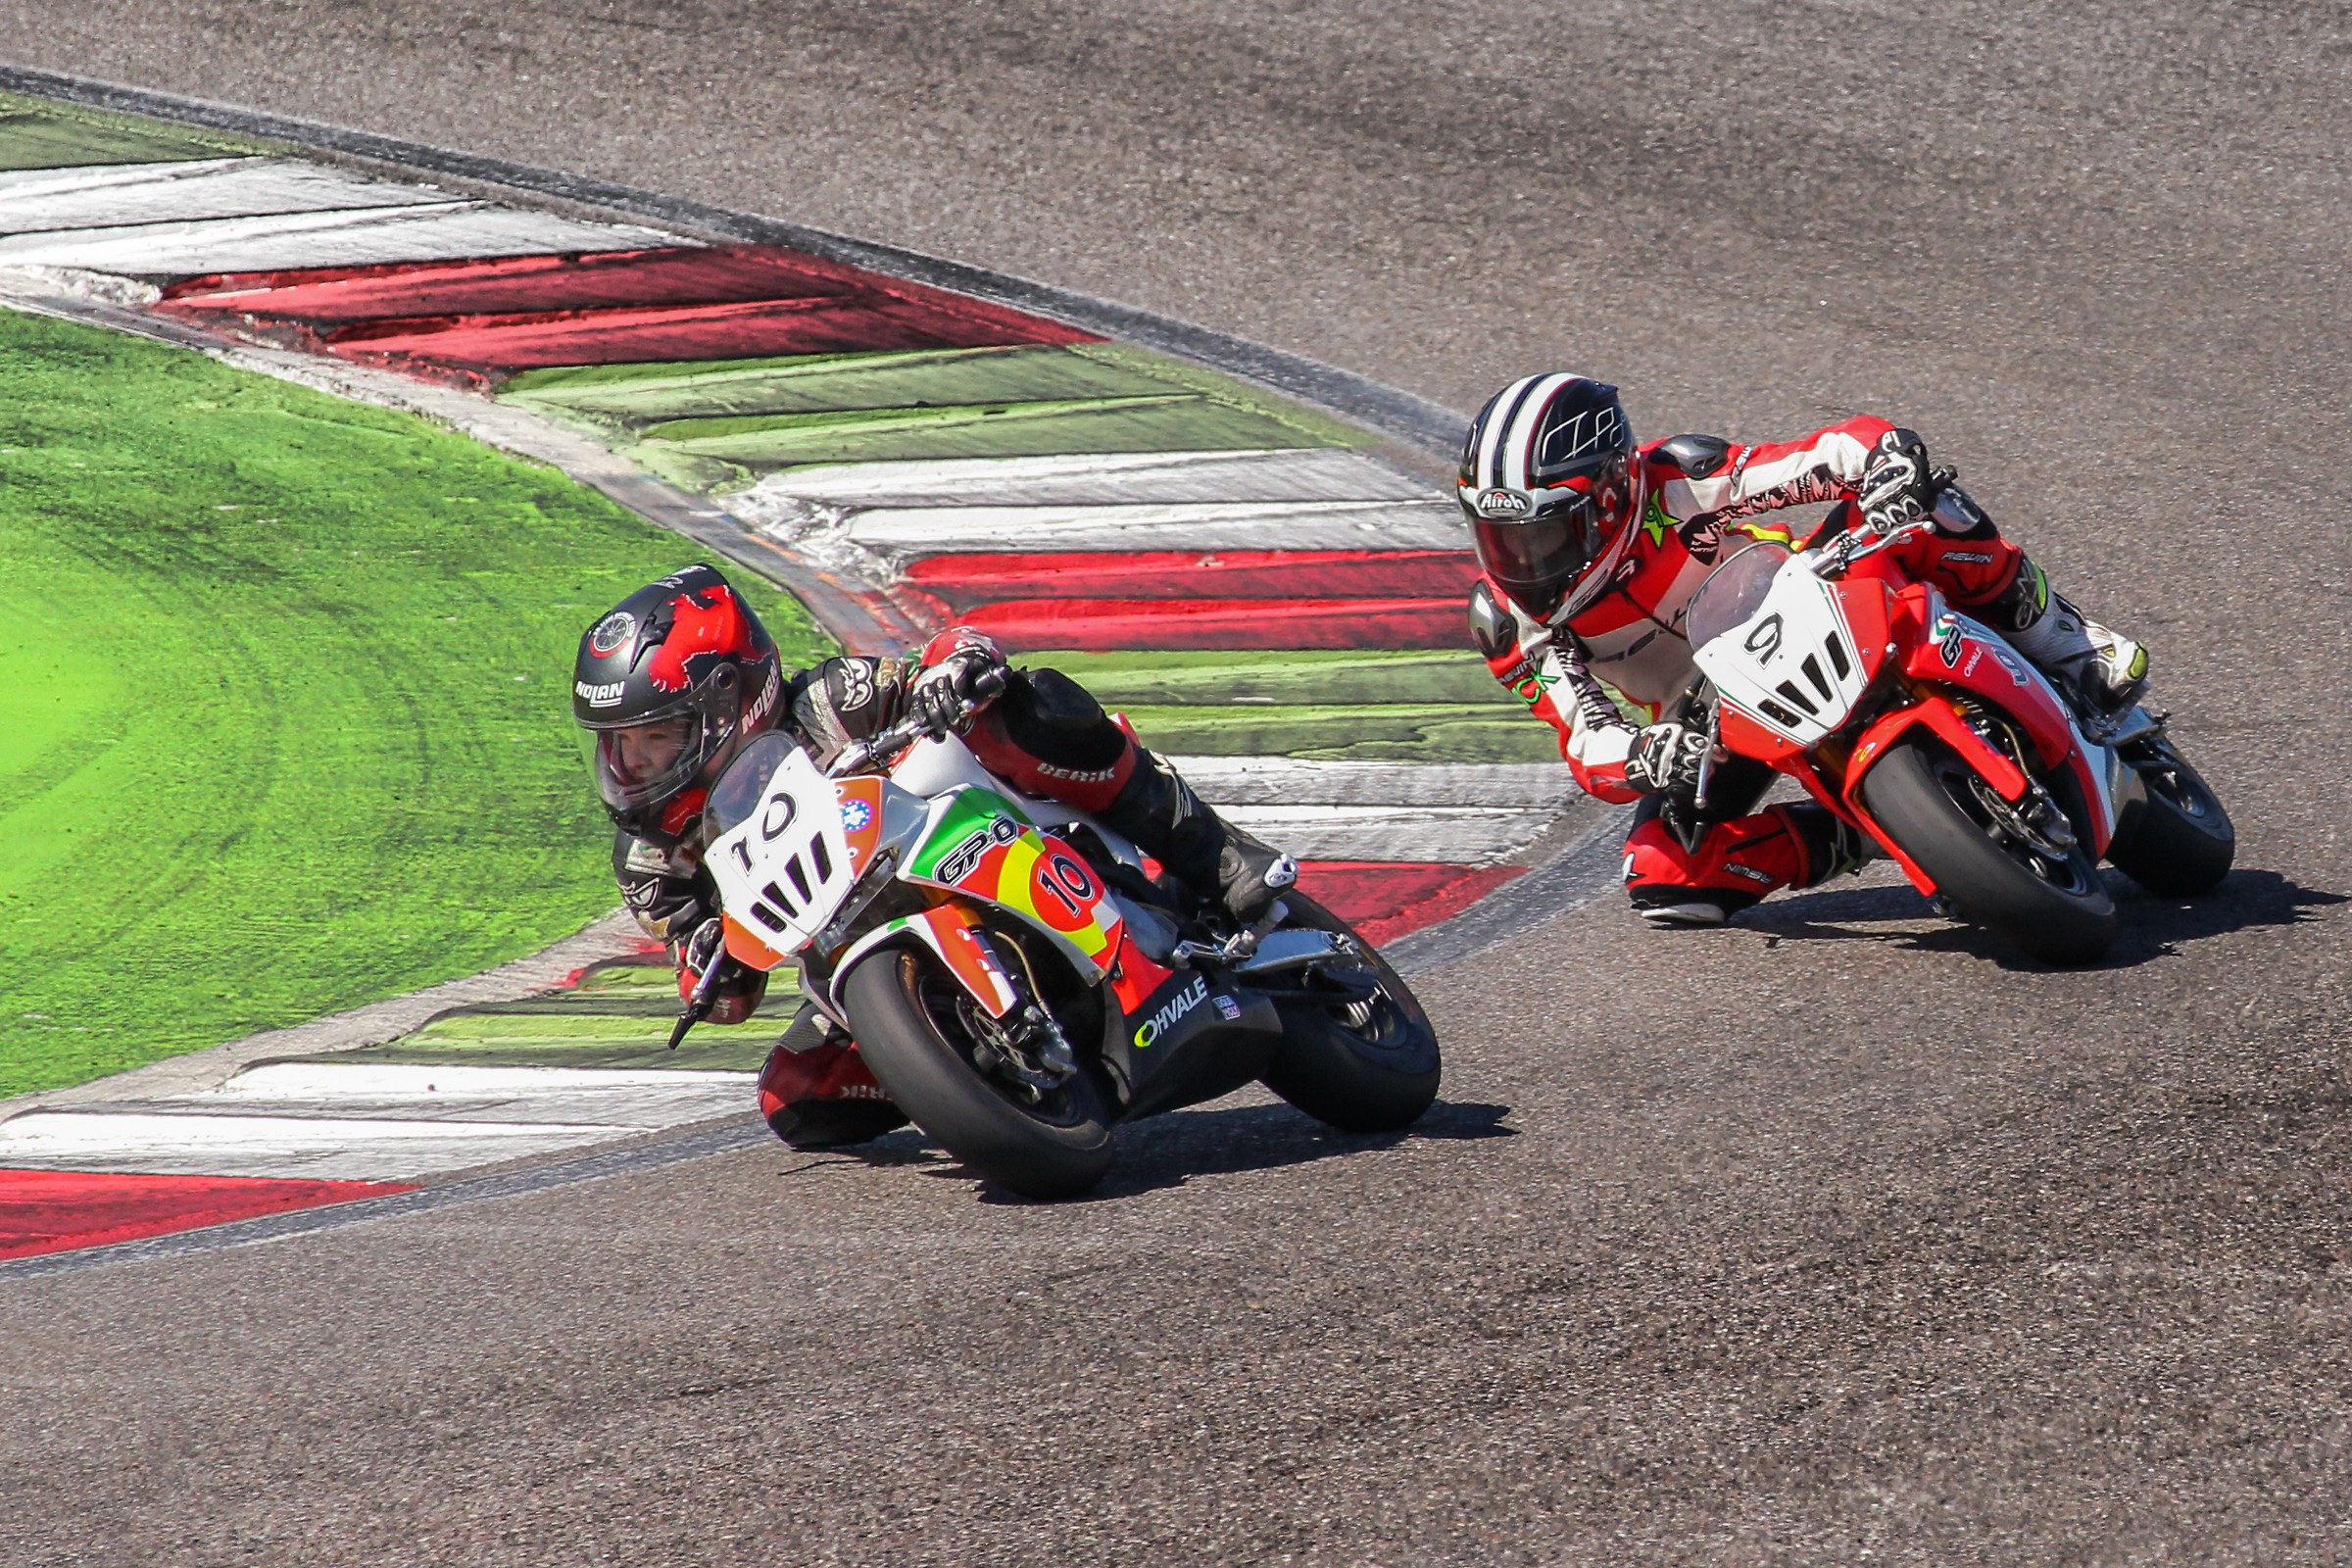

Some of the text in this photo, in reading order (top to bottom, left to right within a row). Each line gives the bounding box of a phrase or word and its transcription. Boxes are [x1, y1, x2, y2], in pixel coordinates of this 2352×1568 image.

[1481, 493, 1526, 510] Airoh
[575, 680, 625, 708] NOLAN
[741, 659, 780, 735] NOLAN
[1037, 854, 1096, 918] 10
[1134, 975, 1208, 1048] OHVALE
